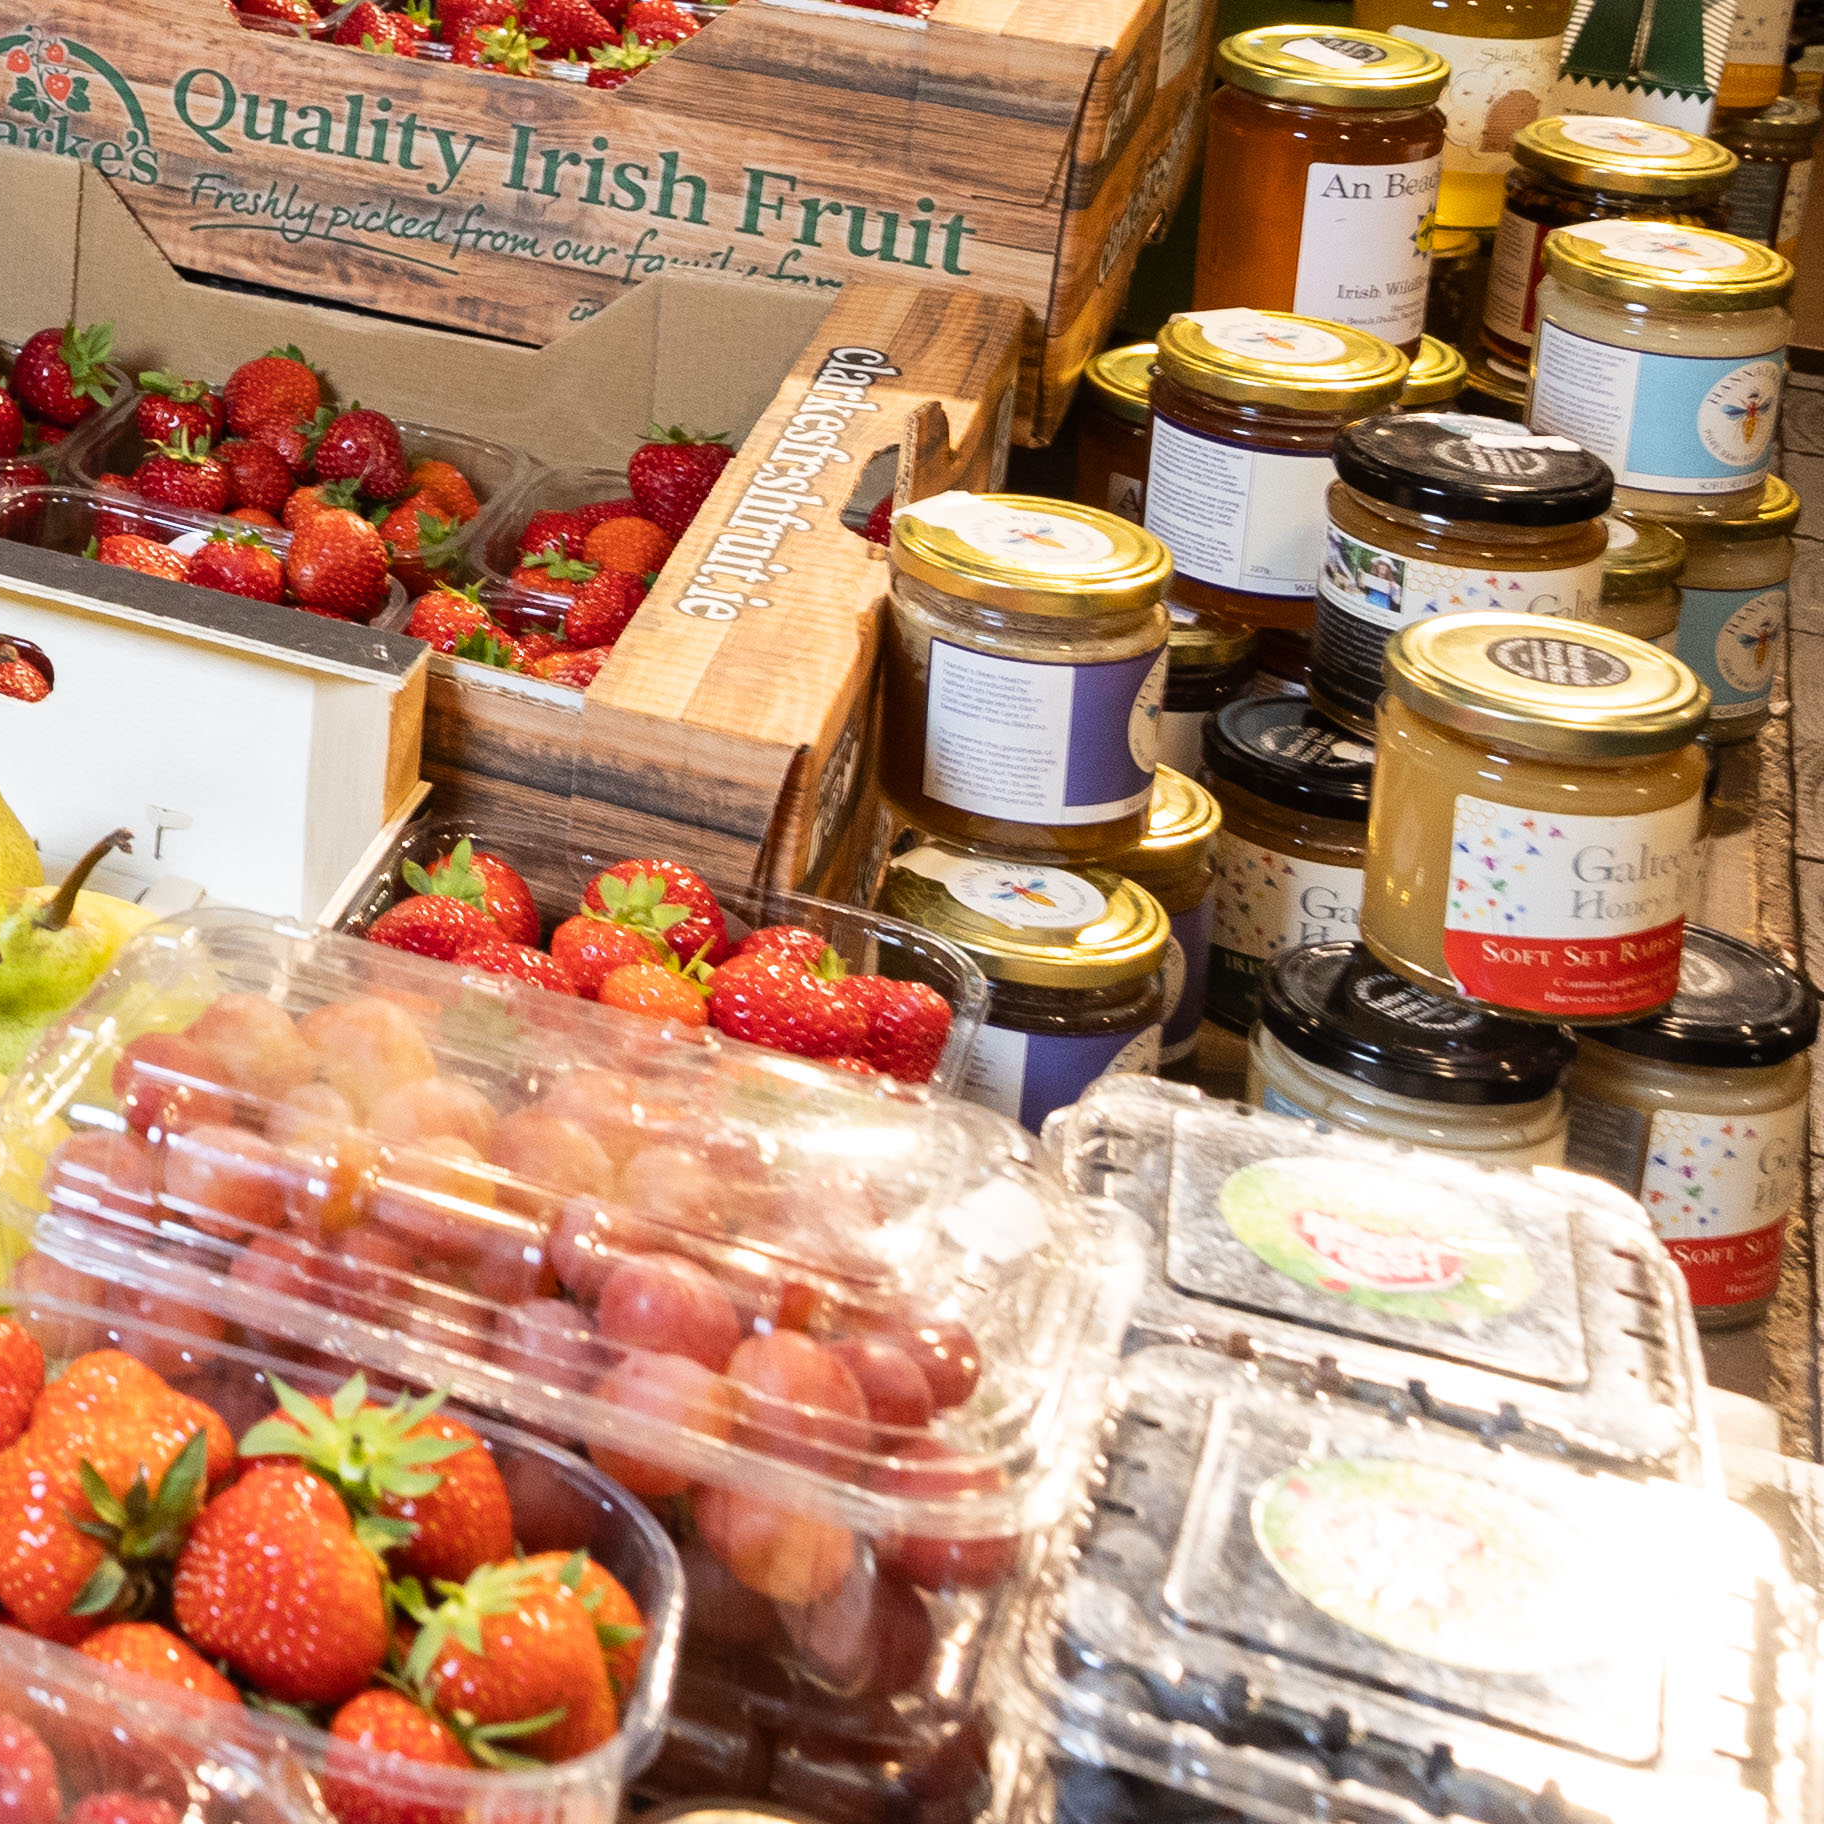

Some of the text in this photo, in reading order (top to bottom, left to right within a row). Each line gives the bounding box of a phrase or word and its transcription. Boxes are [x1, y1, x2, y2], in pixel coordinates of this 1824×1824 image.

[174, 67, 977, 276] Quality Irish Fruit
[1321, 172, 1373, 200] An
[190, 172, 617, 267] Freshly picked from our
[1337, 284, 1380, 300] Irish
[672, 346, 903, 622] clarkesfreshfruit.ie
[1696, 479, 1724, 492] SOFT
[1481, 939, 1612, 970] SOFT SET
[1673, 1241, 1731, 1266] SOFT
